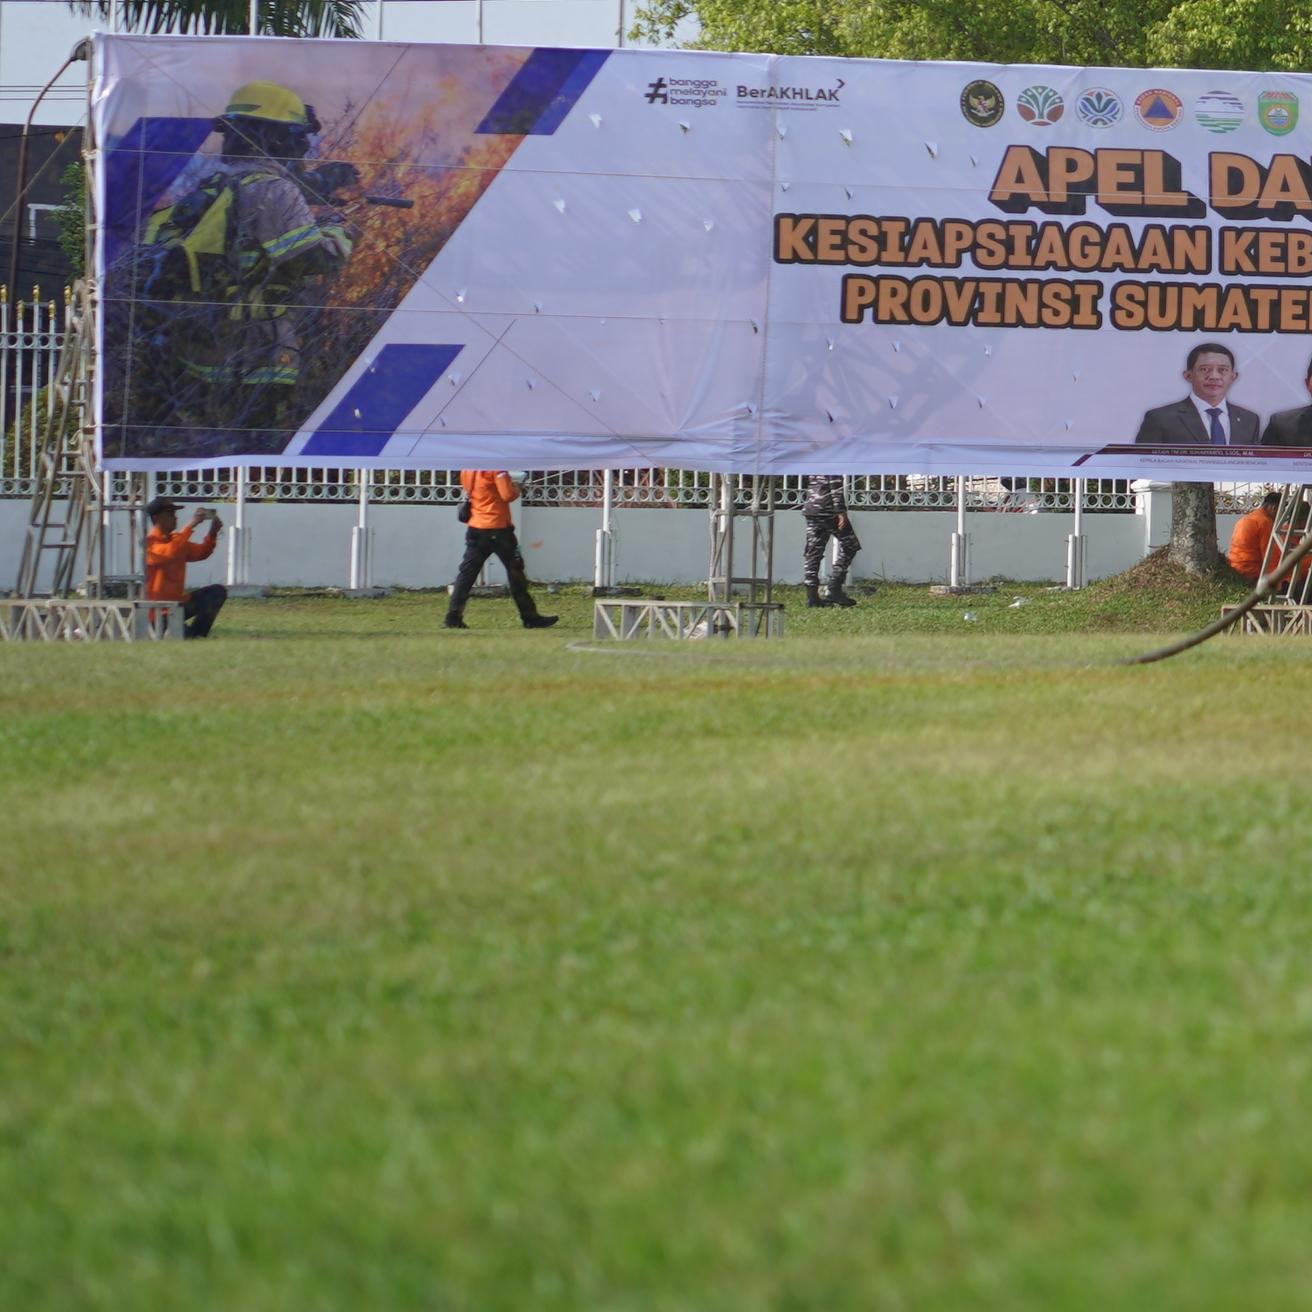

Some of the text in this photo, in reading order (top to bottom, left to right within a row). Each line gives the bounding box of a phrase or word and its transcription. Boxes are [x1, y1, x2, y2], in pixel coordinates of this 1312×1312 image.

[669, 77, 717, 88] bangga
[669, 87, 727, 98] melayani
[736, 85, 841, 102] BerAKHLAK
[669, 97, 717, 107] bangsa
[988, 144, 1205, 219] APEL
[774, 213, 1211, 274] KESIAPSIAGAAN
[841, 273, 1103, 330] PROVINSI
